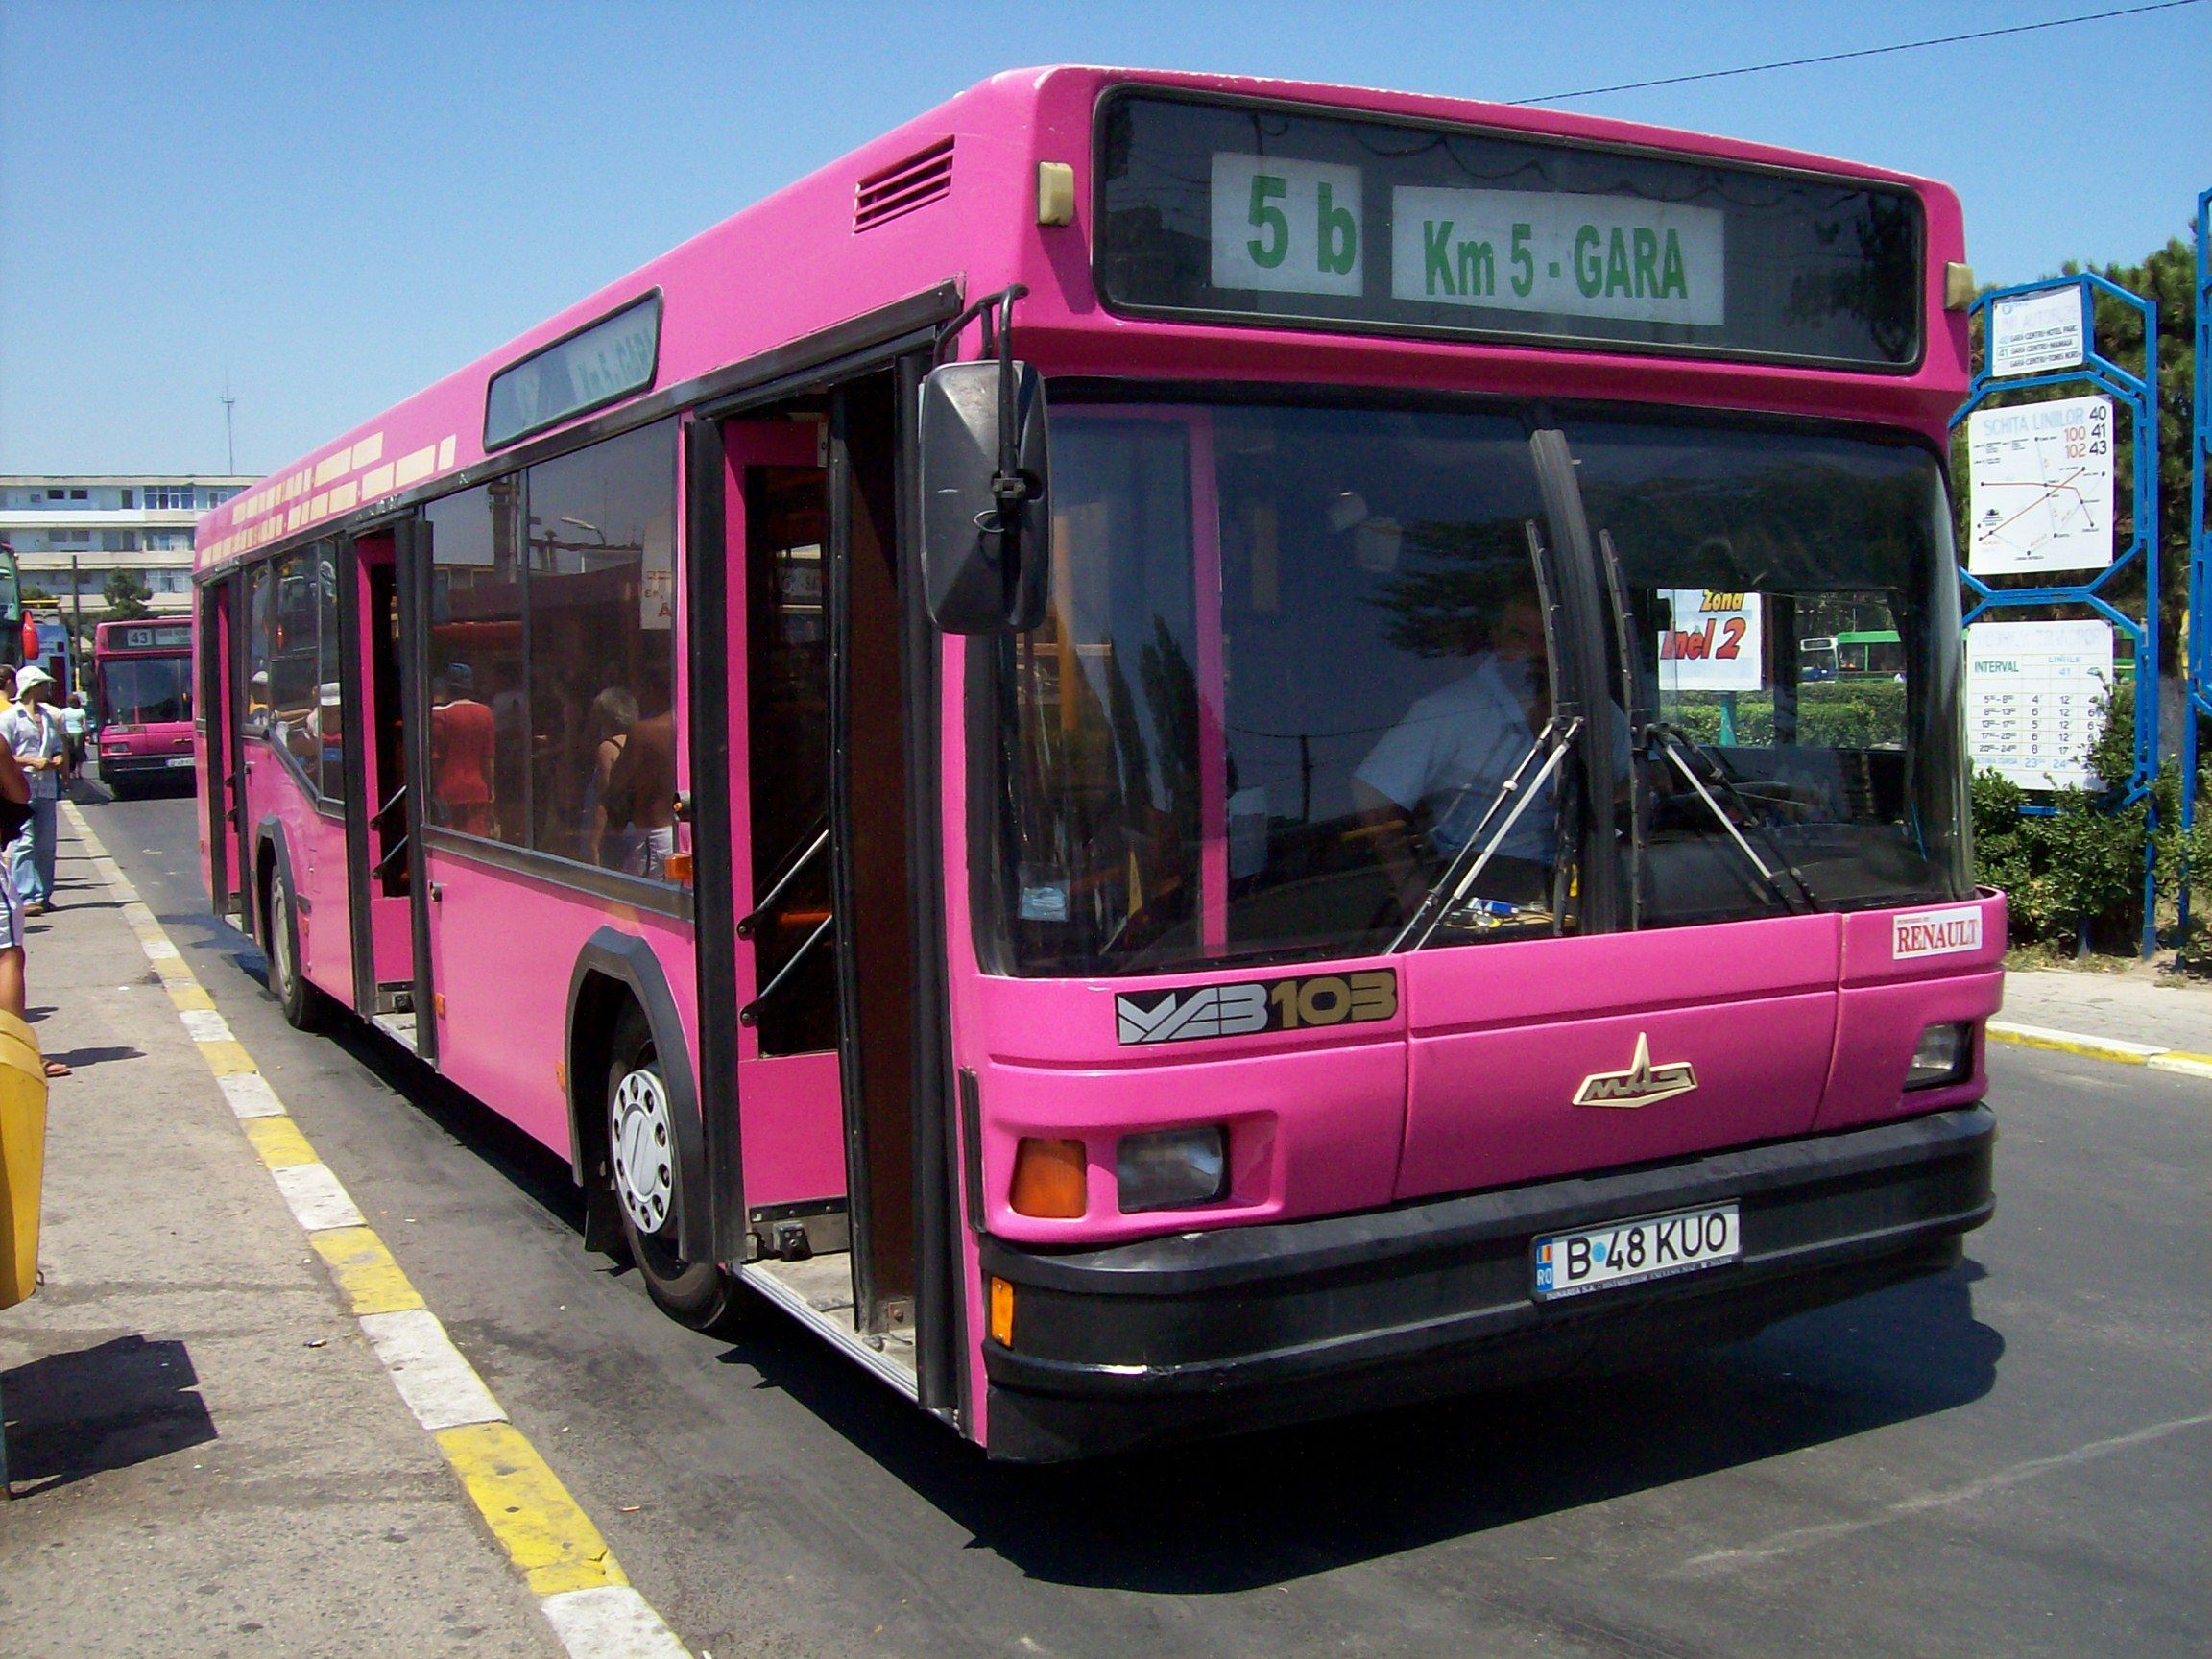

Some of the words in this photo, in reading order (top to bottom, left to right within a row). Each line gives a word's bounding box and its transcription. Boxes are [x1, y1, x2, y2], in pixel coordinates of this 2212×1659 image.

[1247, 174, 1289, 269] 5
[1317, 181, 1356, 276] b
[1423, 220, 1495, 297] Km
[1510, 222, 1533, 298] 5
[1575, 225, 1689, 300] GARA
[2089, 405, 2107, 421] 40
[2064, 425, 2086, 442] 100
[2091, 422, 2106, 438] 41
[2065, 442, 2086, 459] 102
[2089, 440, 2107, 455] 43
[1699, 589, 1744, 612] Zona
[131, 632, 149, 644] 43
[1716, 616, 1746, 660] 2
[1974, 661, 2019, 673] INTERVAL
[1896, 919, 1978, 953] RENAULT
[1567, 1236, 1591, 1281] B
[1605, 1226, 1647, 1271] 48
[1655, 1212, 1727, 1264] KUO
[1537, 1267, 1553, 1286] RO
